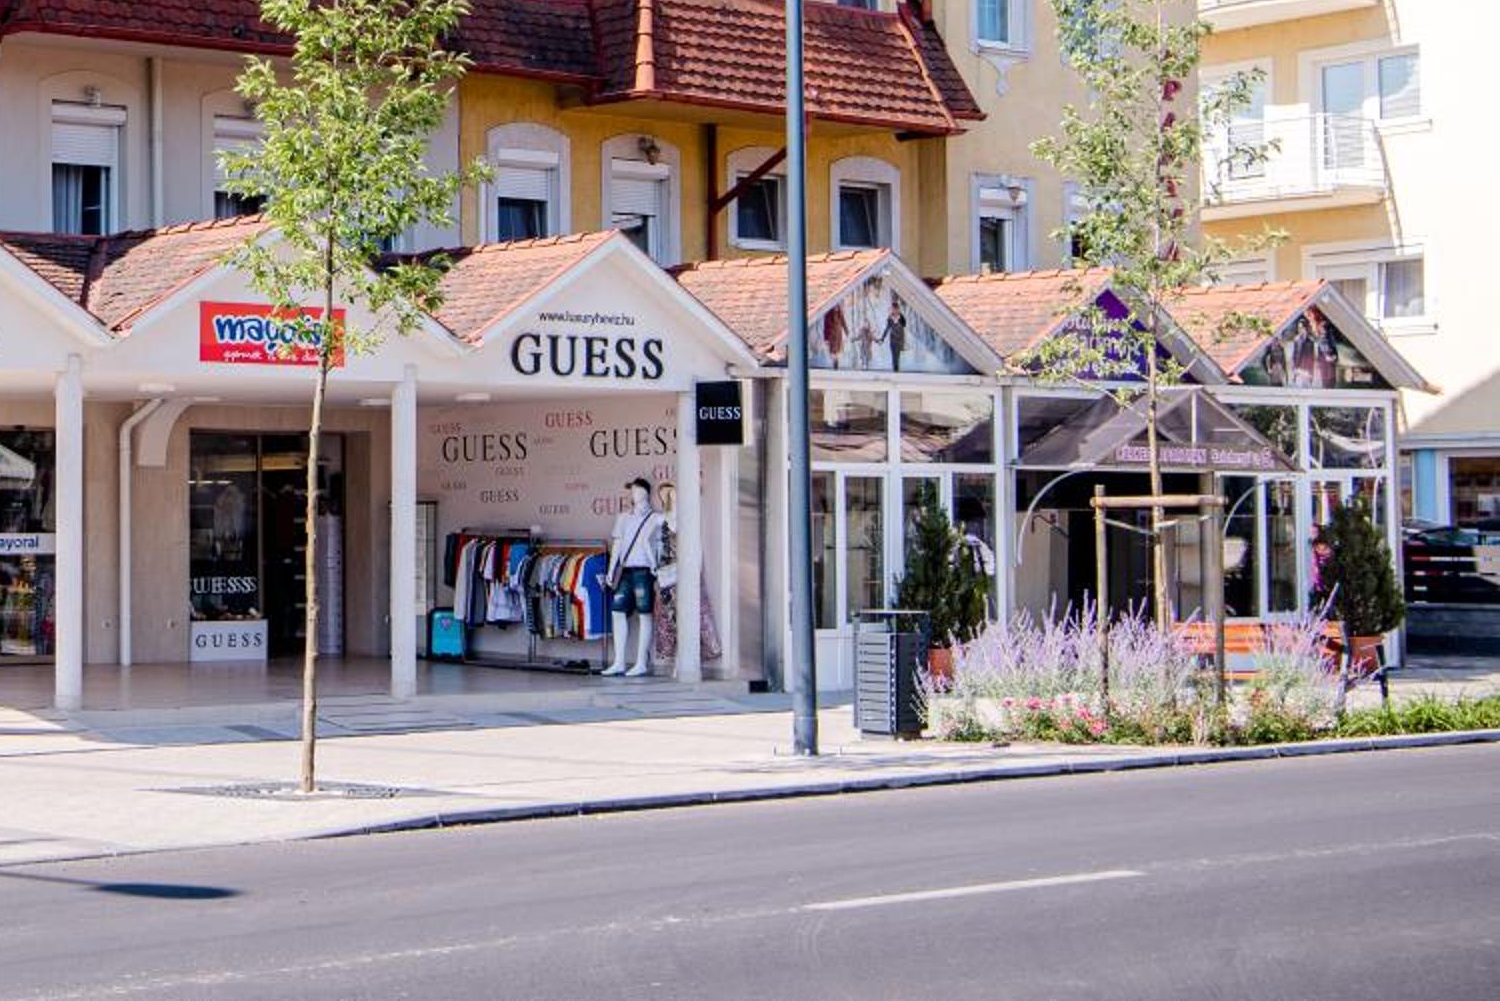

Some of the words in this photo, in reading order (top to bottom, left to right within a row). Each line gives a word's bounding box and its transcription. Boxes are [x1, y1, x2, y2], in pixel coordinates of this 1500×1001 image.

[511, 332, 664, 380] GUESS
[545, 411, 593, 428] GUESS
[699, 406, 741, 420] GUESS
[442, 432, 528, 463] GUESS
[481, 488, 520, 504] GUESS
[592, 497, 636, 515] GUE
[195, 632, 262, 648] GUESS
